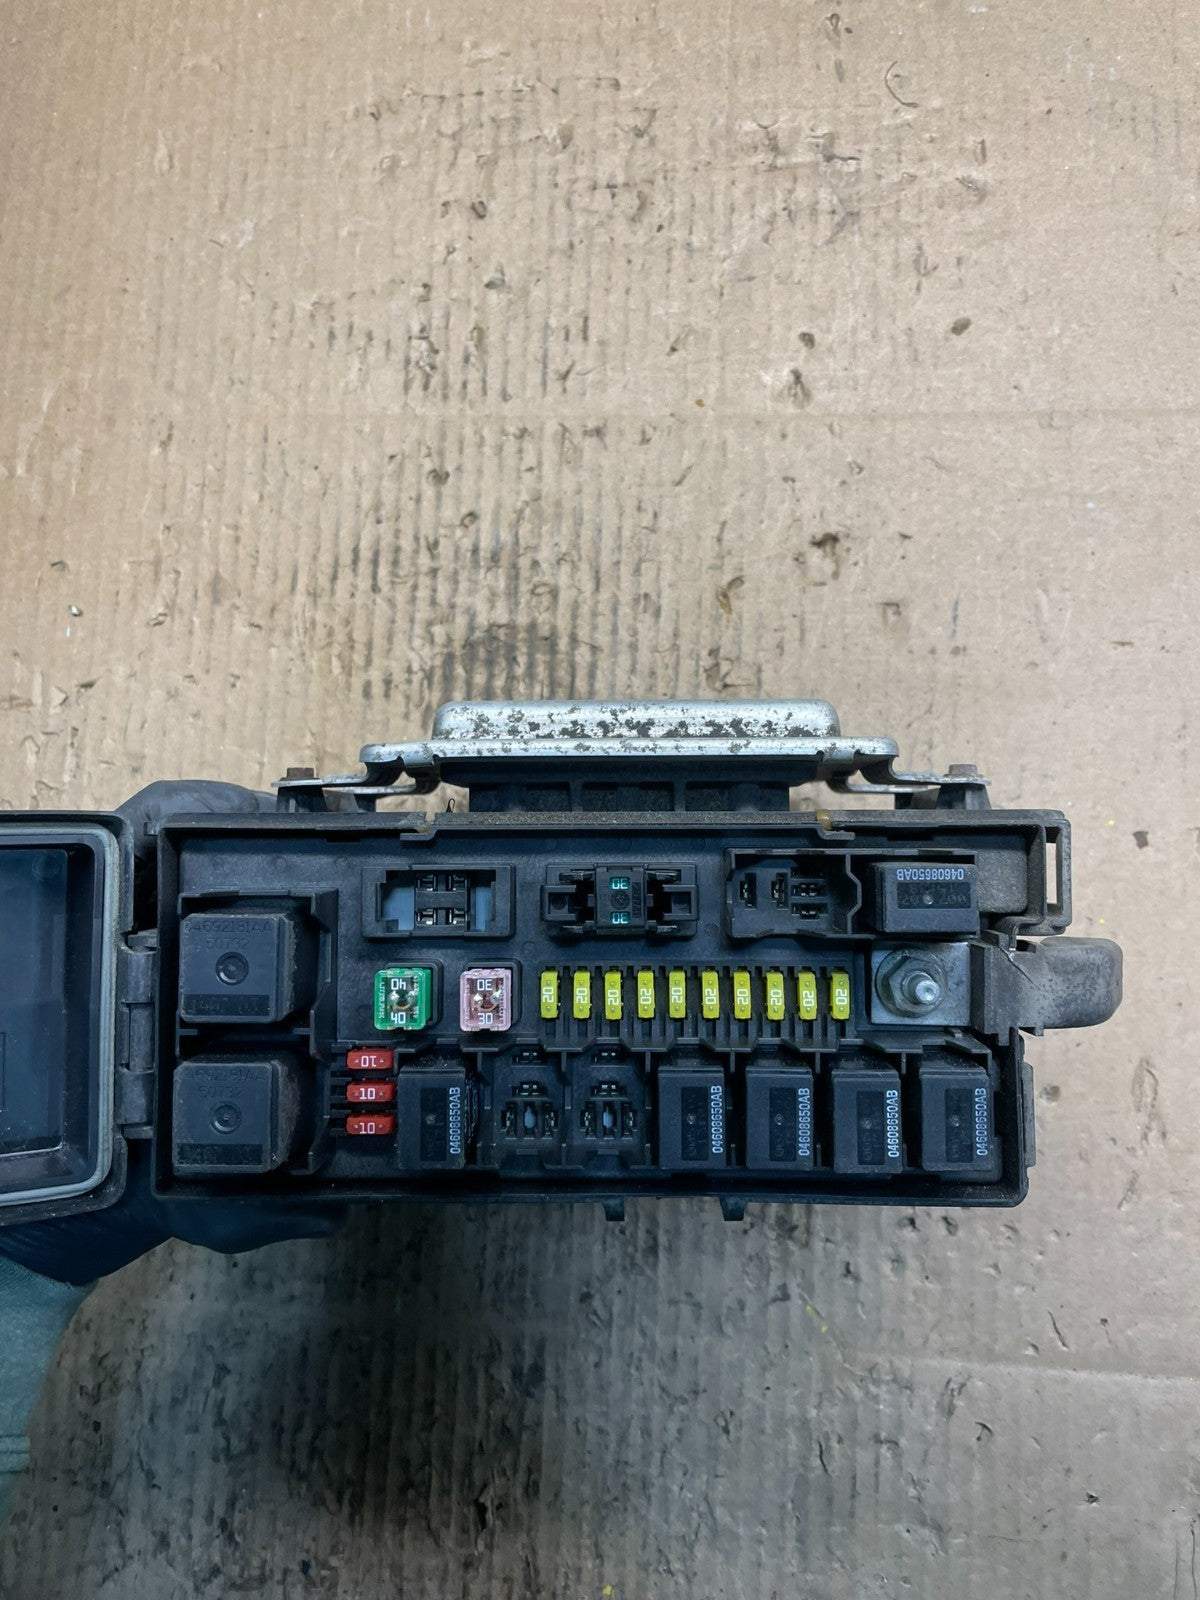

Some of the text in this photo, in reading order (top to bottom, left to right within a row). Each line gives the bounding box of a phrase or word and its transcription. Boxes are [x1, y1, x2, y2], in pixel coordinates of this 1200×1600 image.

[896, 868, 964, 881] 04608650AB
[390, 978, 407, 991] 40
[476, 979, 493, 991] 30
[542, 986, 555, 1003] 20
[575, 987, 588, 1004] 20
[607, 989, 620, 1006] 20
[640, 988, 652, 1005] 20
[671, 986, 683, 1004] 20
[704, 988, 717, 1005] 20
[736, 988, 749, 1005] 20
[770, 989, 783, 1006] 20
[802, 990, 815, 1007] 20
[835, 988, 848, 1005] 20
[390, 1012, 407, 1024] 40
[477, 1012, 494, 1025] 30
[360, 1055, 377, 1068] 10
[359, 1087, 376, 1100] 10
[449, 1086, 461, 1154] 04608650AB
[711, 1085, 723, 1154] 04608650AB
[798, 1087, 811, 1156] 04608650AB
[886, 1089, 900, 1158] 04608650AB
[974, 1087, 988, 1156] 04608650AB
[359, 1122, 376, 1135] 10
